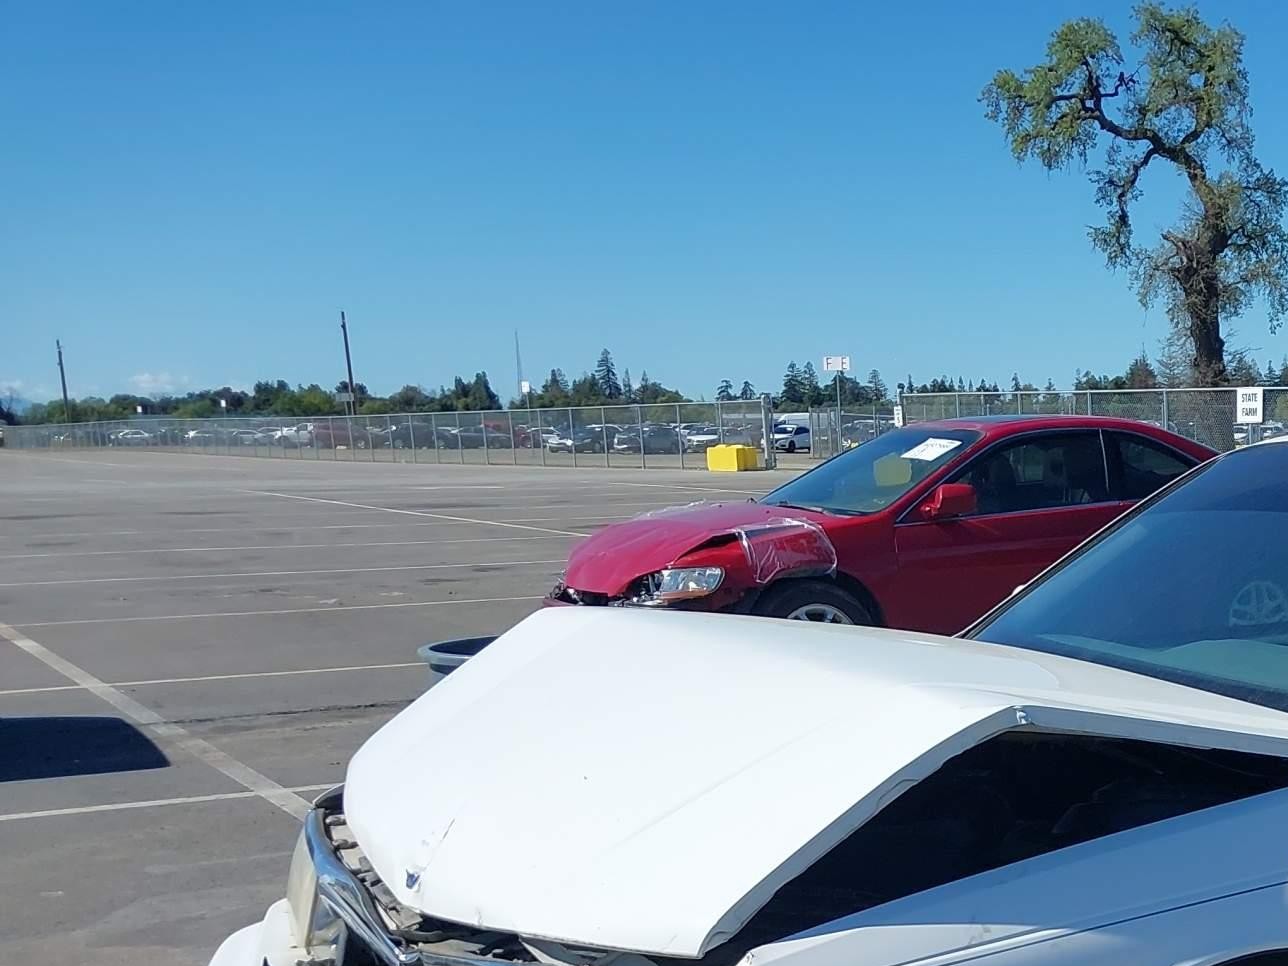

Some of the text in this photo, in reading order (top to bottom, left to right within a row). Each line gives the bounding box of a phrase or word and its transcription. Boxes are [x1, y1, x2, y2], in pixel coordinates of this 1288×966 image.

[825, 356, 848, 370] F E
[1241, 393, 1258, 403] STATE
[1241, 407, 1258, 417] FARM
